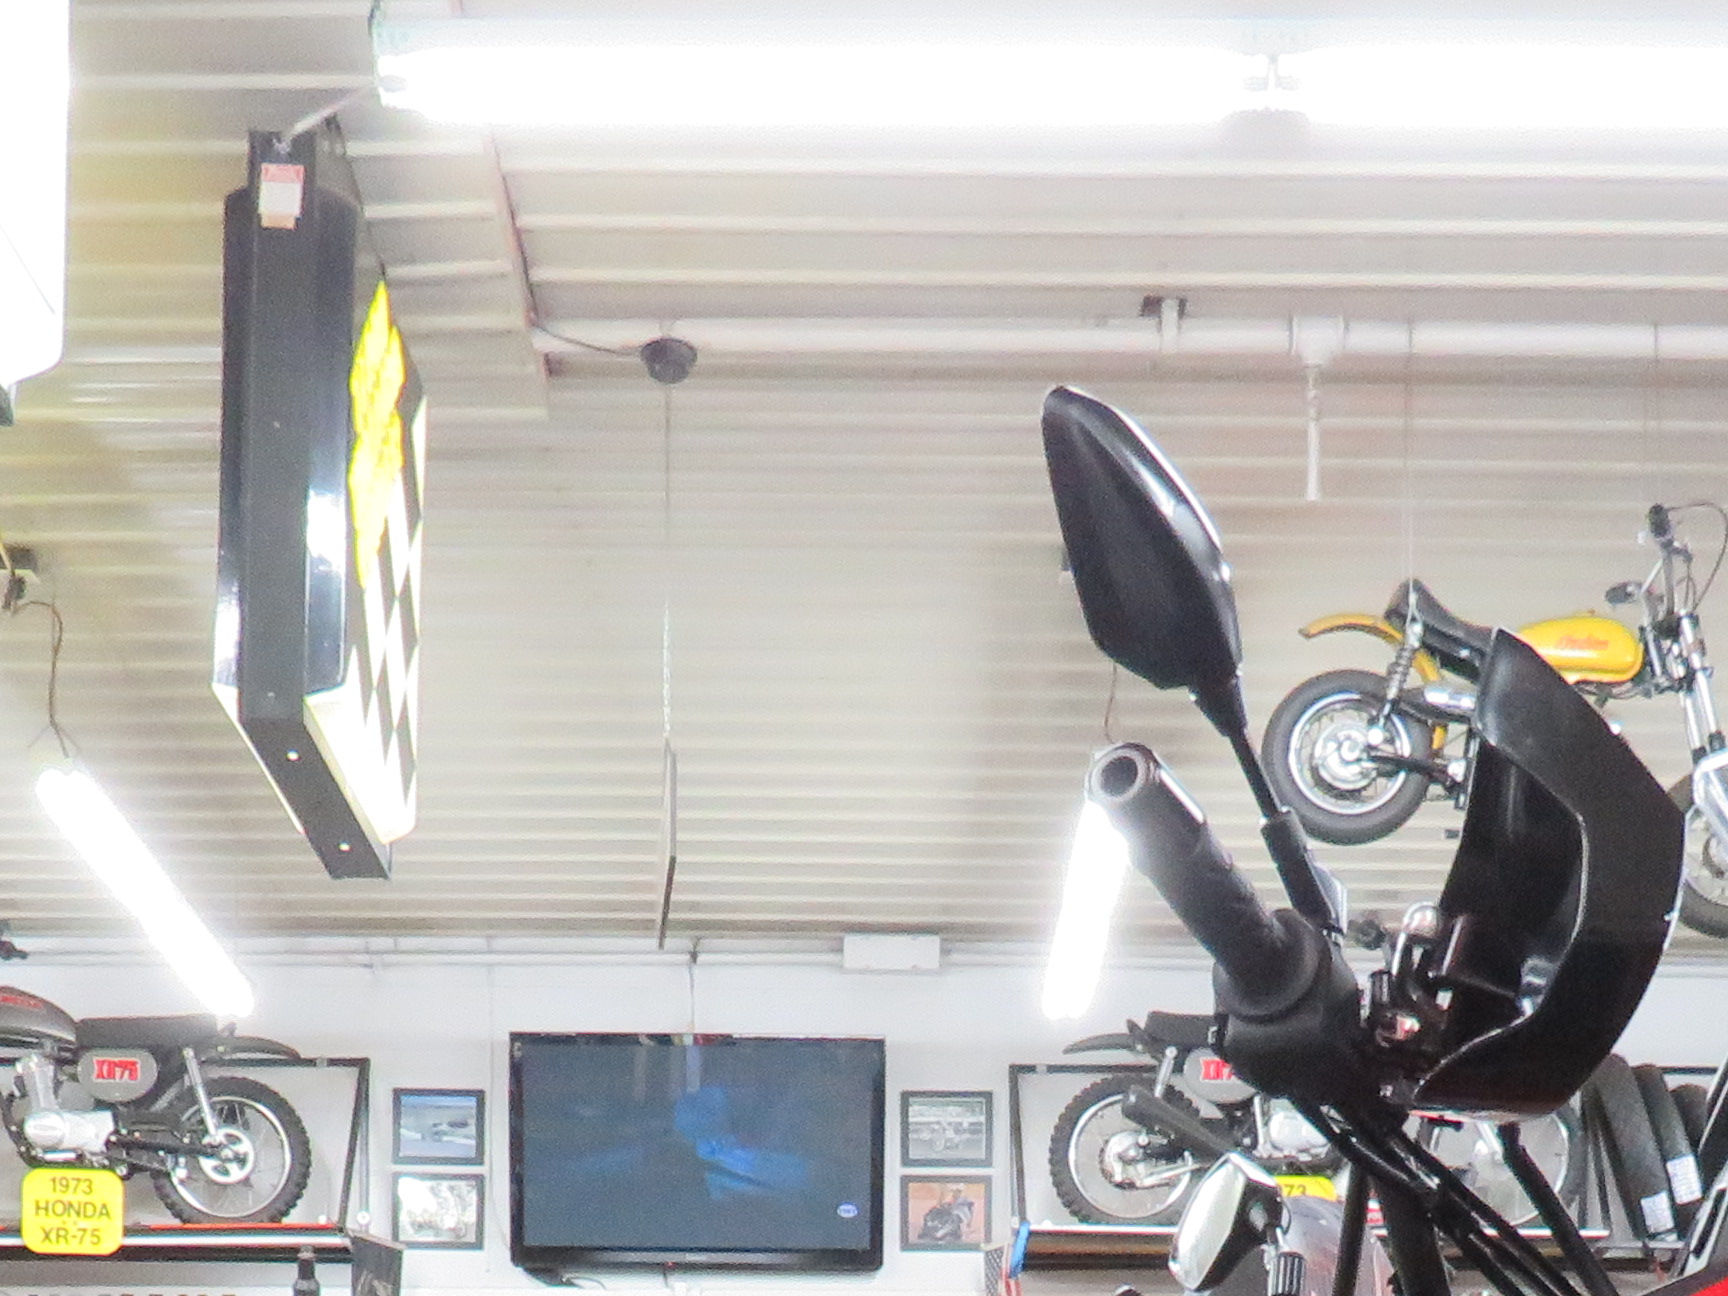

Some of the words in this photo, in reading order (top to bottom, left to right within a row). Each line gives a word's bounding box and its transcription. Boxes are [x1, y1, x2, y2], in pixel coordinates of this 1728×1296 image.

[50, 1176, 94, 1196] 1973
[34, 1199, 112, 1220] HONDA
[40, 1226, 102, 1246] XR-75
